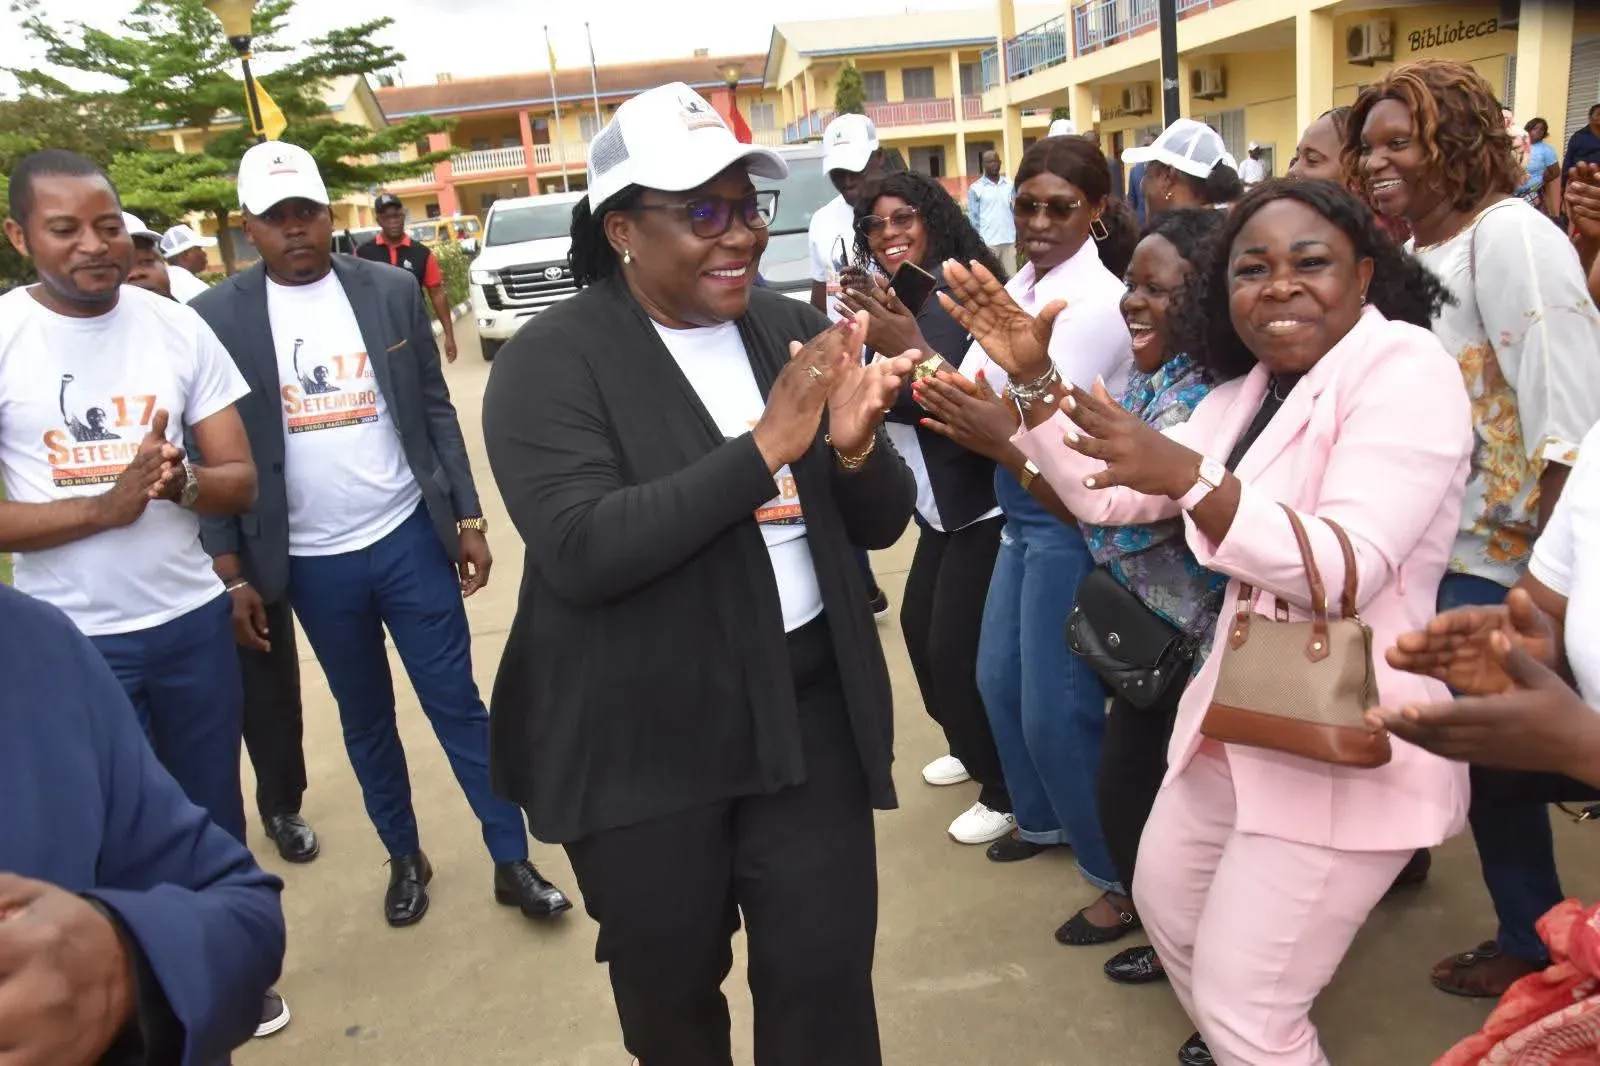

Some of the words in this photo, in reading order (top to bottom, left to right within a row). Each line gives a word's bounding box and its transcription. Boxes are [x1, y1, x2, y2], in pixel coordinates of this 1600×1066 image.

[1408, 16, 1498, 51] Biblioteca
[332, 352, 369, 381] 17
[111, 394, 157, 427] 17
[43, 429, 141, 465] SETEM
[61, 478, 74, 486] DO
